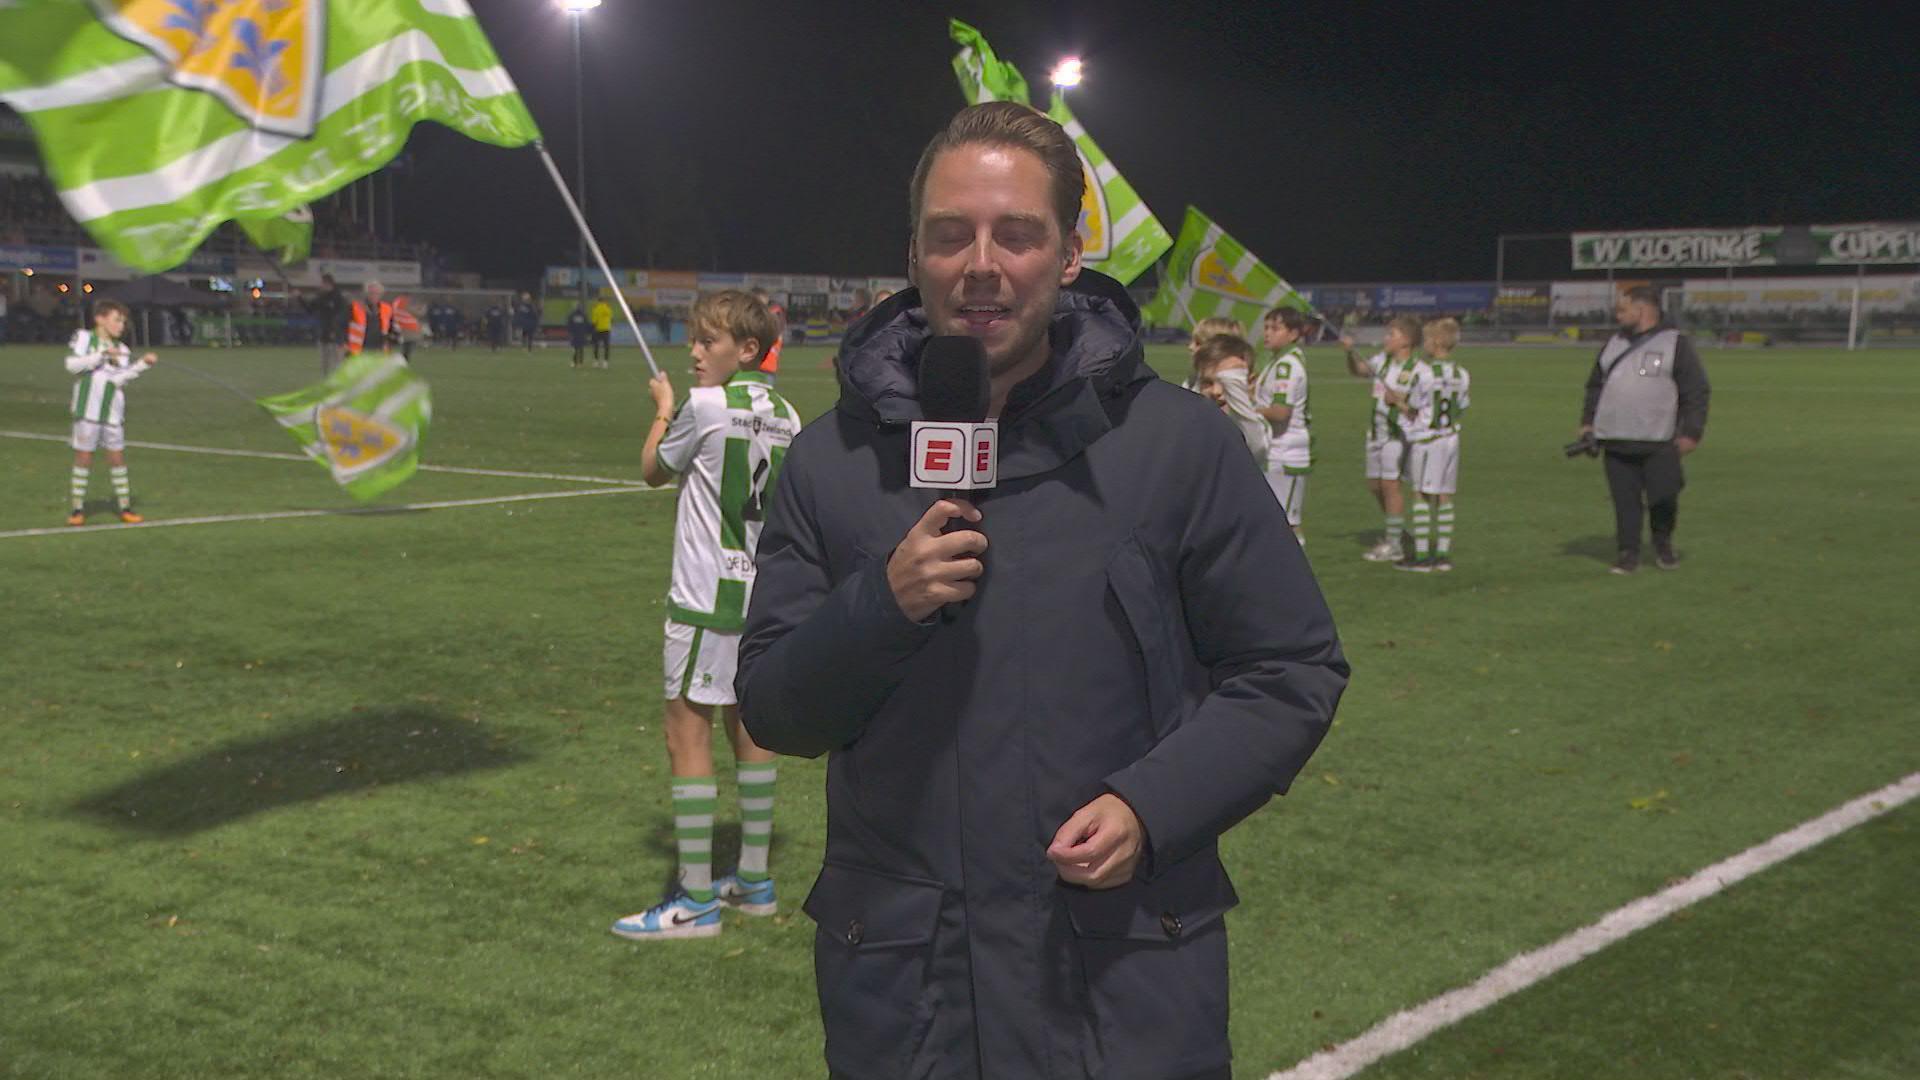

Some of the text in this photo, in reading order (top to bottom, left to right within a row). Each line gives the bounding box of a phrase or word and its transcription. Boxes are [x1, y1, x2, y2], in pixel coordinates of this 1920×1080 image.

[1631, 232, 1761, 263] KLOETINGE
[1439, 398, 1452, 428] 8
[923, 439, 953, 471] E
[976, 441, 990, 472] E
